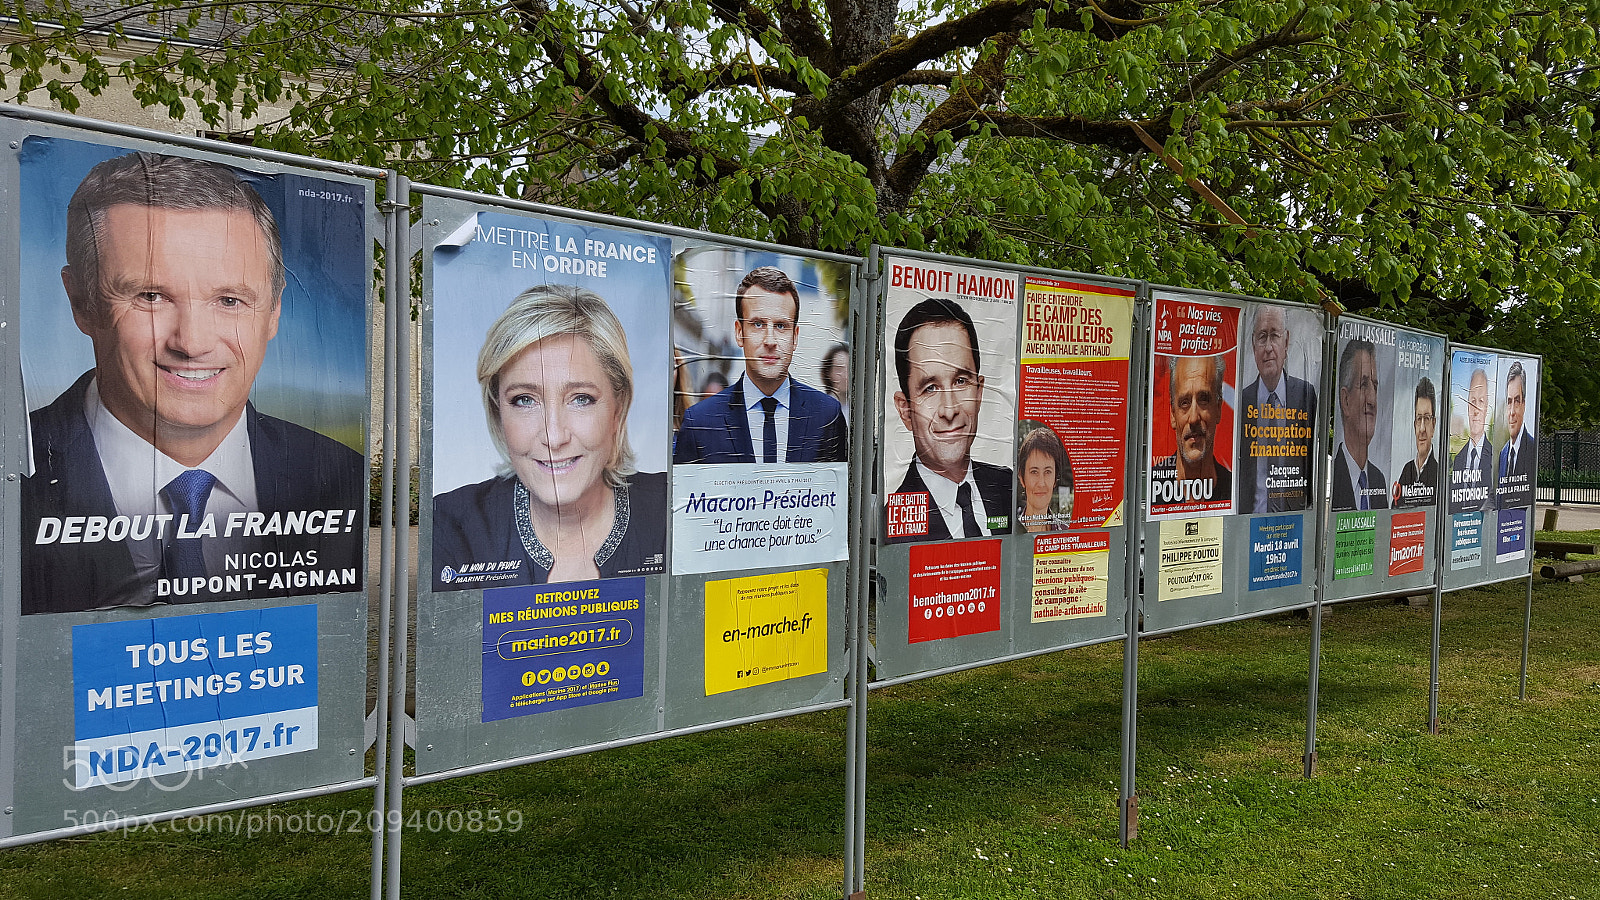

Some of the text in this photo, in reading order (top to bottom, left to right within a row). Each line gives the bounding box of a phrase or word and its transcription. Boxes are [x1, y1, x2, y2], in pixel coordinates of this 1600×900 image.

[298, 188, 353, 203] nda-2017.fr
[472, 225, 656, 264] METTRE LA FRANCE
[512, 251, 607, 278] EN ORDRE
[892, 264, 1014, 300] BENOIT HAMON
[1027, 292, 1046, 304] FAIRE
[1048, 294, 1083, 307] ENTENDRE
[1026, 304, 1102, 326] LE CAMP DES
[1187, 306, 1223, 324] Nos vies,
[1026, 323, 1113, 344] TRAVAILLEURS
[1157, 330, 1172, 342] NPA
[1178, 322, 1217, 338] pas leurs
[1340, 322, 1396, 346] JEAN LASSALLE
[1026, 343, 1110, 356] AVEC NATHALIE ARTHAUD
[1398, 351, 1430, 370] PEUPLE
[1247, 403, 1308, 421] Se libérer de
[1244, 423, 1312, 442] l'occupation
[1249, 441, 1308, 457] financière
[1153, 456, 1176, 467] VOTEZ
[1153, 470, 1178, 479] PHILIPPE
[1270, 465, 1300, 480] Jacques
[1452, 469, 1482, 484] UN CHOIX
[1152, 478, 1213, 503] POUTOU
[1265, 476, 1307, 489] Cheminade
[1402, 484, 1434, 497] Mélenchon
[1496, 487, 1508, 496] POUR
[1514, 484, 1530, 493] FRANCE
[685, 488, 836, 514] Macron Président
[889, 493, 927, 506] FAIRE BATTRE
[1452, 487, 1489, 503] HISTORIQUE
[888, 507, 899, 524] LE
[1337, 516, 1376, 531] JEAN LASSALLE
[35, 514, 173, 545] DEBOUT
[176, 513, 218, 539] LA
[735, 517, 770, 533] France
[772, 515, 791, 531] doit
[794, 515, 813, 529] être
[888, 522, 927, 536] DE LA FRANCE
[704, 538, 725, 551] une
[728, 534, 766, 550] chance
[769, 535, 794, 551] pour
[1037, 536, 1080, 546] FAIRE ENTENDRE
[1072, 541, 1107, 549] TRAVAILLEURS
[1254, 539, 1299, 553] Mardi 18 avril
[225, 550, 318, 571] NICOLAS
[1162, 548, 1219, 564] PHILIPPE POUTOU
[1266, 552, 1287, 564] 19h30
[1389, 543, 1424, 566] jlm2017.fr
[459, 560, 521, 573] AU NOM DU PEUPLE
[157, 568, 356, 597] DUPONT-AIGNAN
[455, 573, 519, 583] MARINE Présidente
[1035, 575, 1063, 584] réunions
[535, 588, 600, 604] RETROUVEZ
[913, 586, 996, 608] benoithamon2017.fr
[1034, 585, 1088, 597] consultez le site
[1034, 596, 1079, 606] de campagne
[489, 599, 639, 624] MES RÉUNIONS PUBLIQUES
[1033, 603, 1104, 618] nathalie-arthaud.info
[722, 613, 812, 643] en-marche.fr
[511, 627, 621, 653] marine2017.fr
[126, 631, 273, 668] TOUS LES
[88, 664, 305, 711] MEETINGS SUR
[512, 692, 546, 701] Applications
[89, 722, 300, 777] NDA-2017.fr
